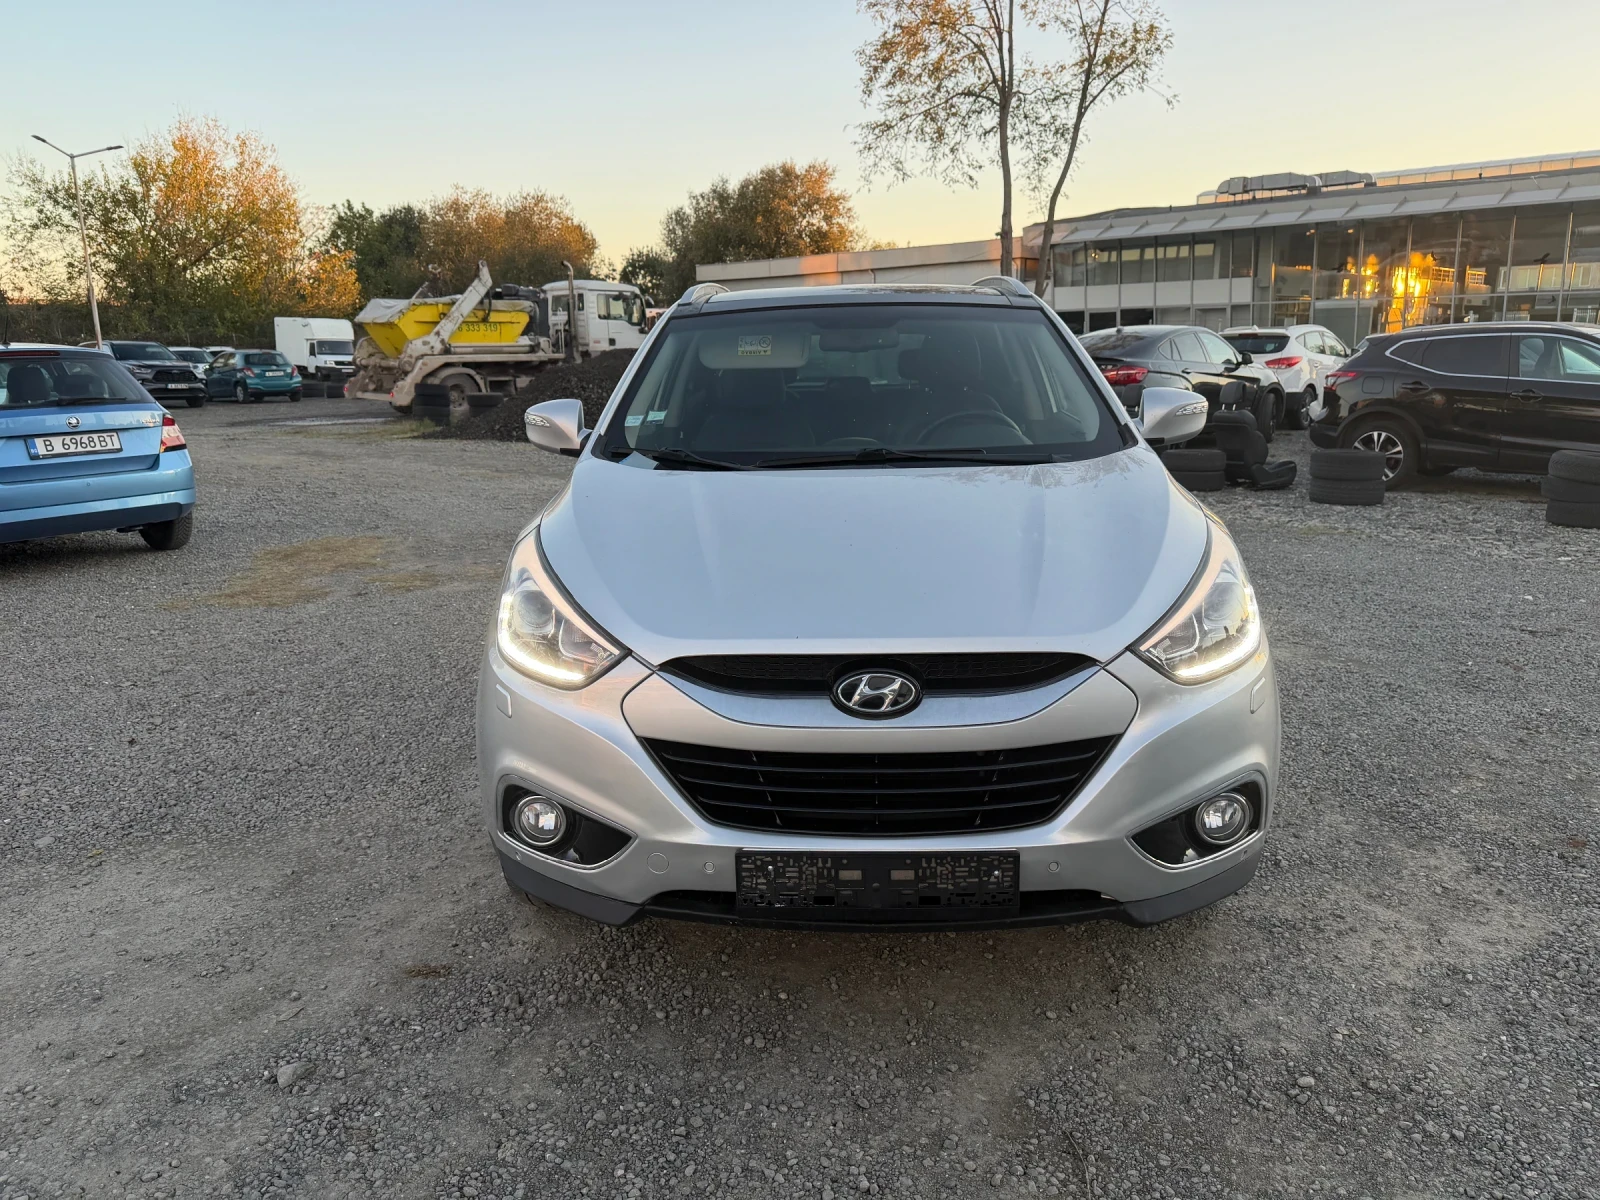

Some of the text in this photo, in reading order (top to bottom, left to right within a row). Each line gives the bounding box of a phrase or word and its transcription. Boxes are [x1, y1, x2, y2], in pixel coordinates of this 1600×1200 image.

[465, 323, 480, 332] 333
[483, 323, 498, 332] 319
[43, 439, 54, 452] B
